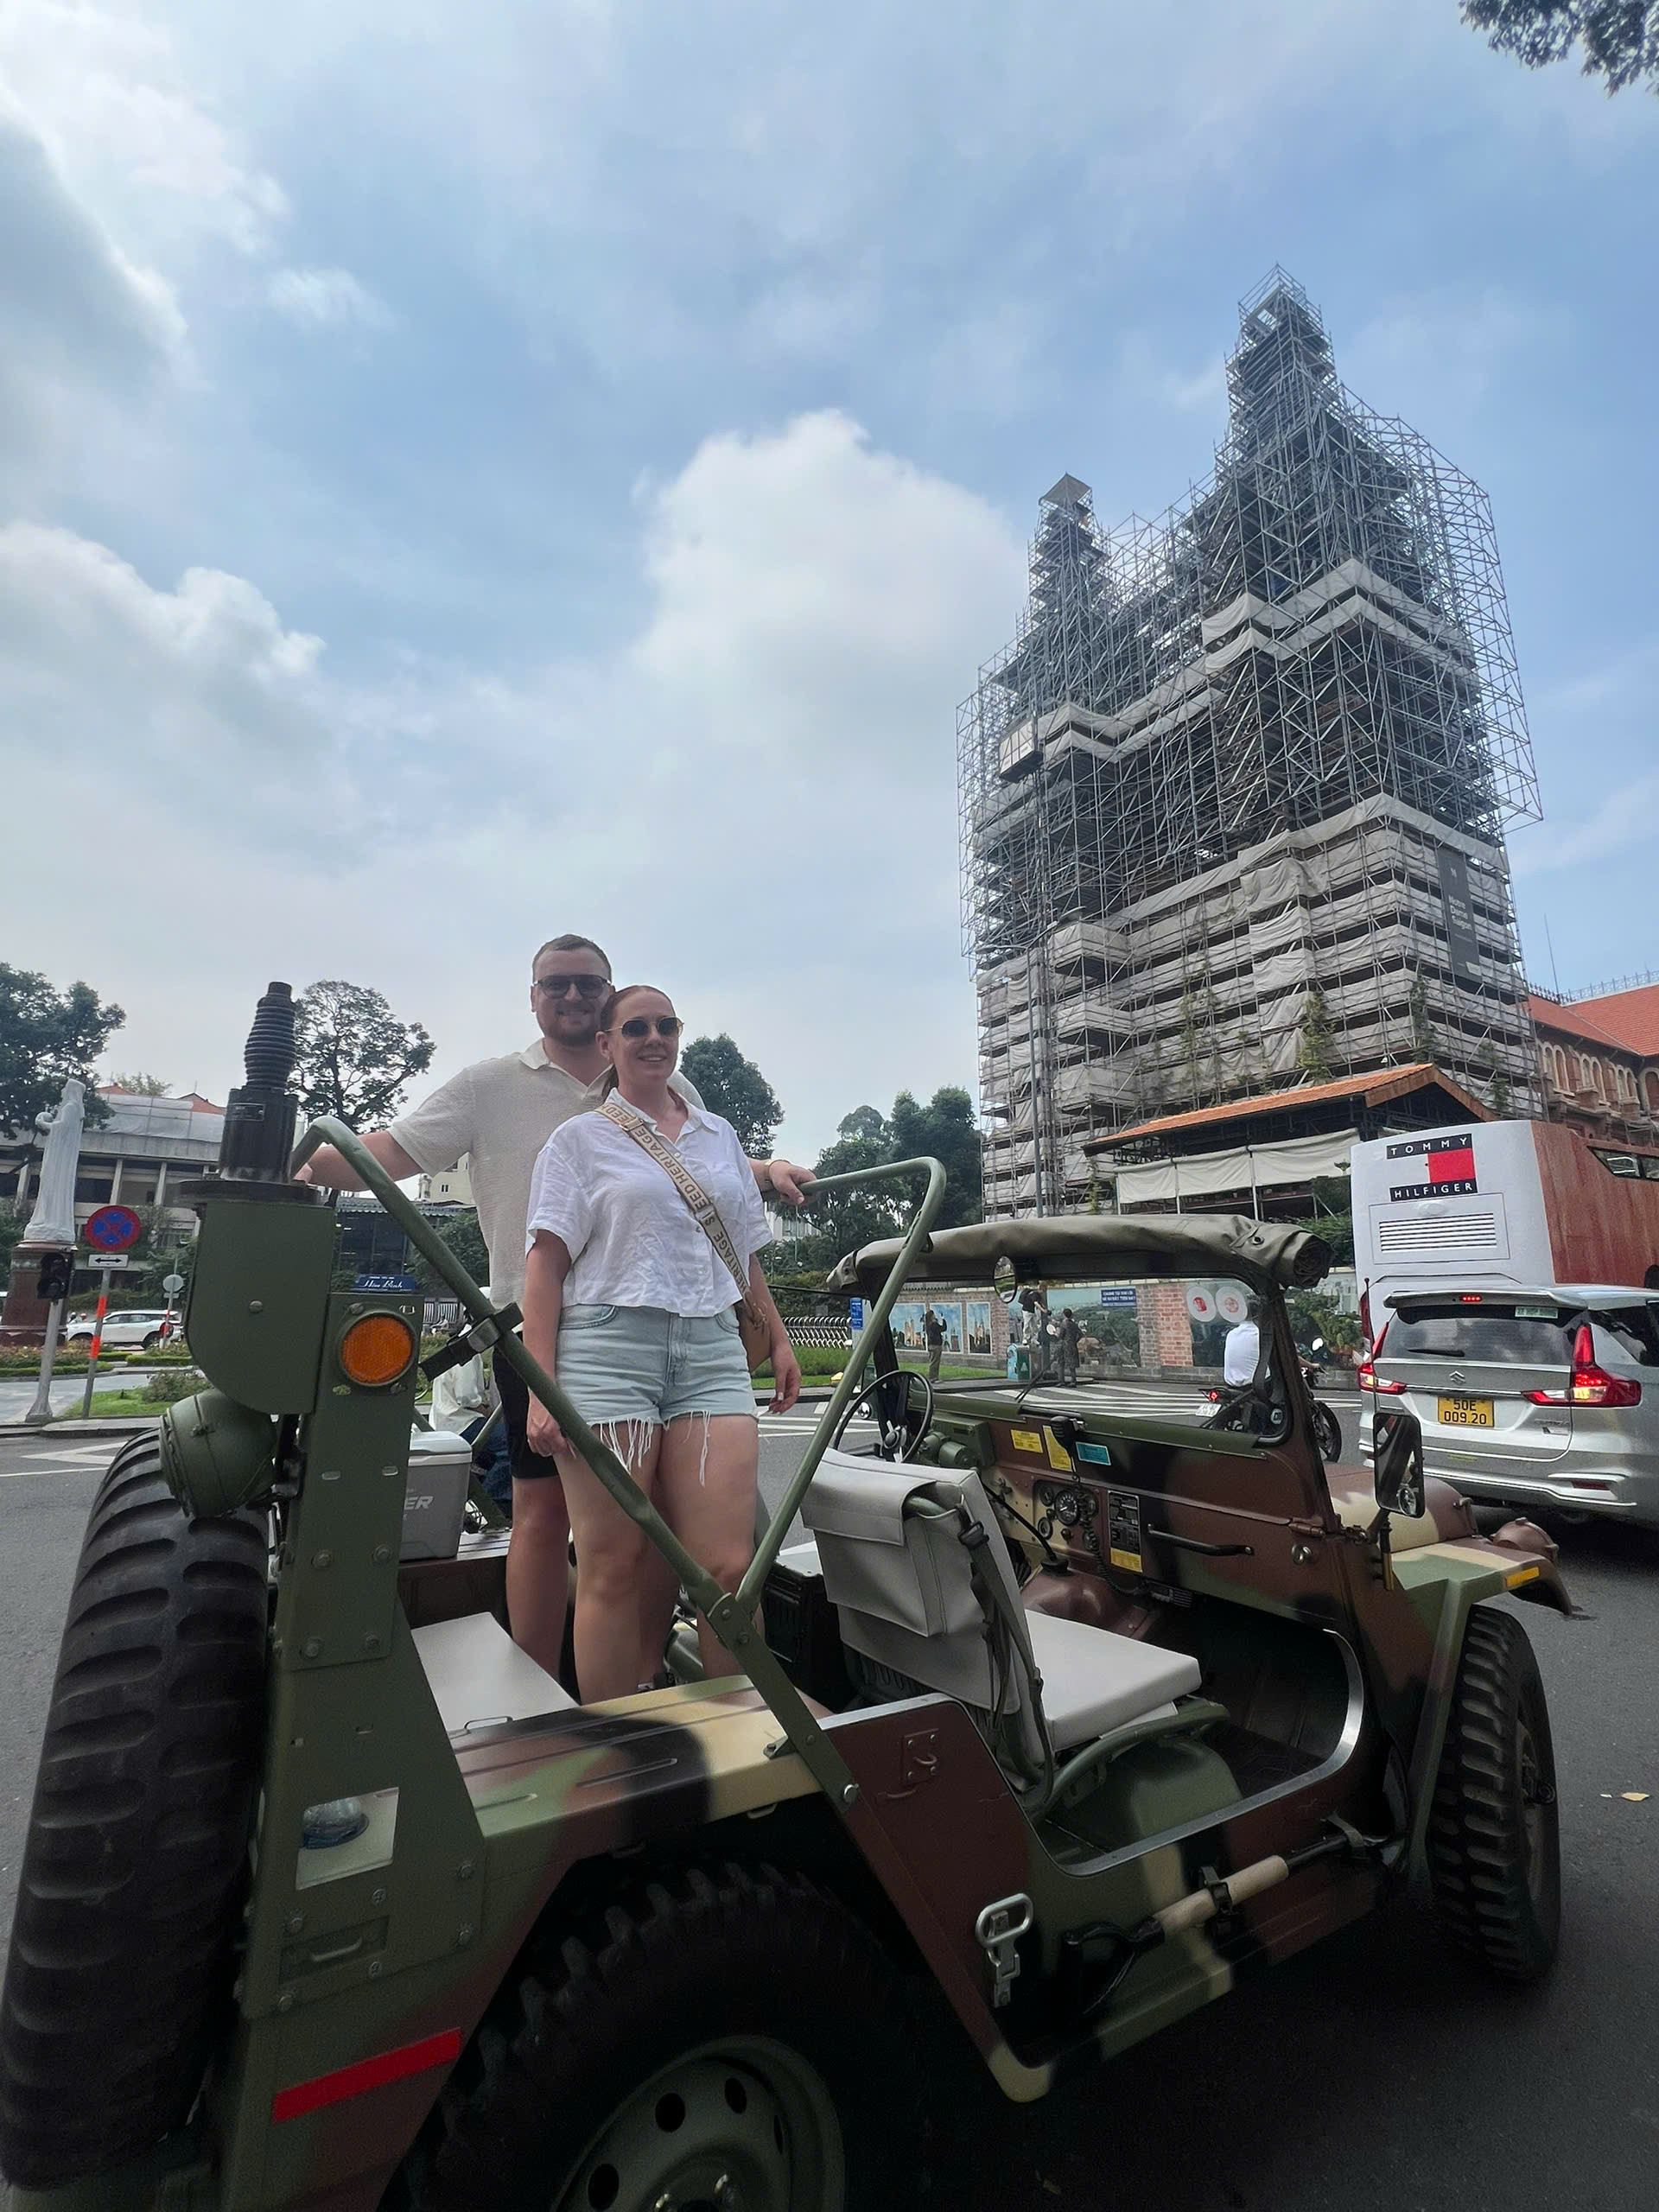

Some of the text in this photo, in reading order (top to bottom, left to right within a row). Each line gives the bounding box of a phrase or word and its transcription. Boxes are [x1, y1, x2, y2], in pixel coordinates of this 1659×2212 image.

[605, 1106, 630, 1126] EED
[1390, 1137, 1467, 1155] TOMMY
[634, 1128, 690, 1185] HERITAGE
[1394, 1183, 1473, 1198] HILFIGER
[1453, 1399, 1477, 1411] 50E
[1444, 1411, 1487, 1425] 009.20
